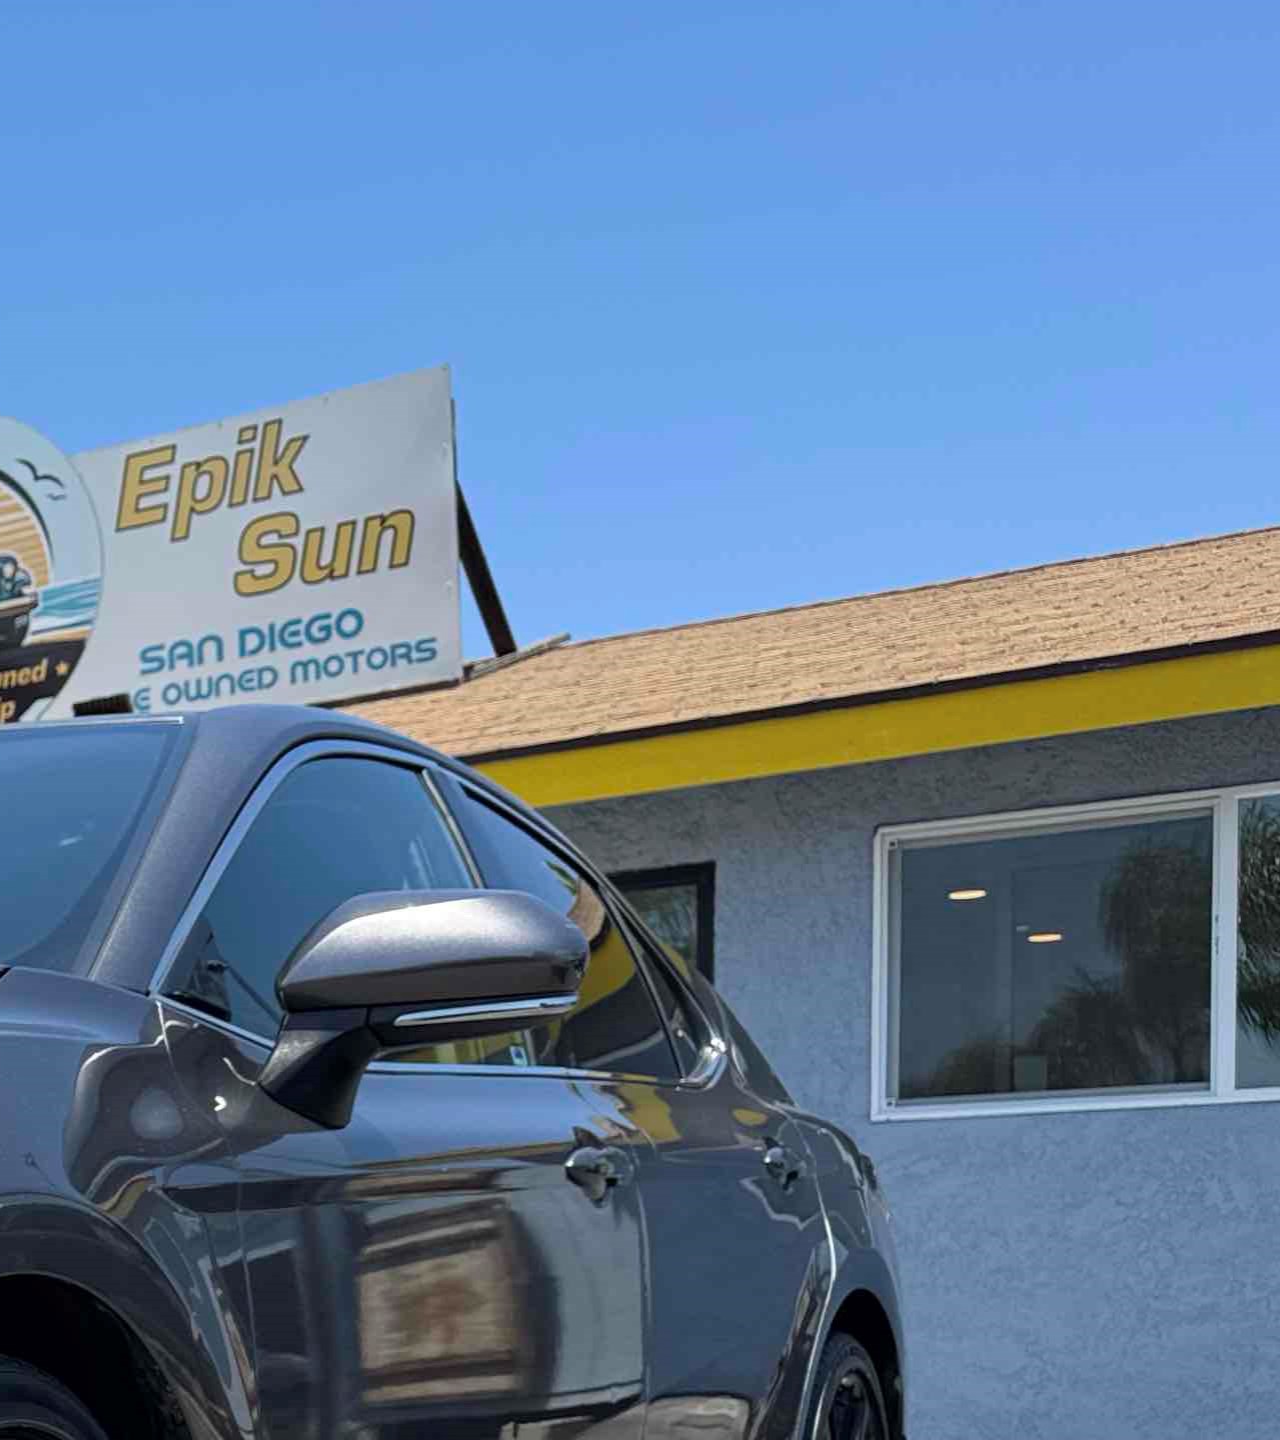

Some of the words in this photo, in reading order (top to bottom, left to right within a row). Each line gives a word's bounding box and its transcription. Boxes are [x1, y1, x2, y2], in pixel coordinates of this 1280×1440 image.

[115, 417, 310, 542] Epik
[233, 508, 416, 597] Sun
[139, 634, 224, 675] SAN
[238, 607, 364, 658] DIEGO
[161, 665, 279, 706] OWNED
[289, 637, 438, 685] MOTORS
